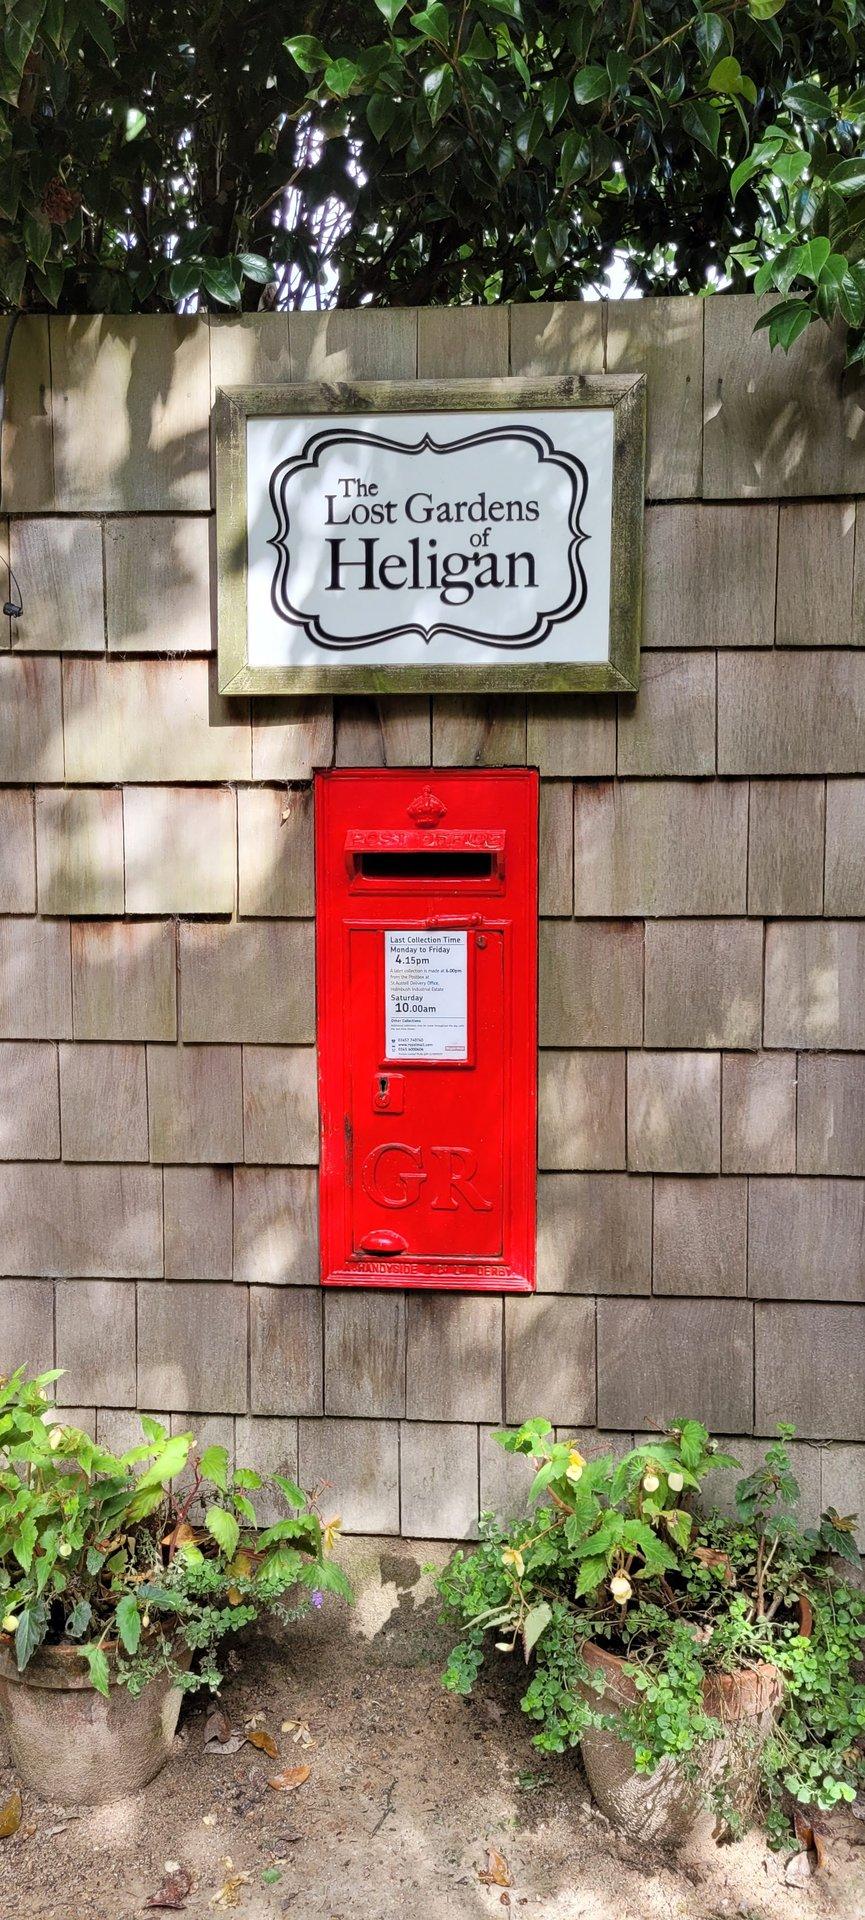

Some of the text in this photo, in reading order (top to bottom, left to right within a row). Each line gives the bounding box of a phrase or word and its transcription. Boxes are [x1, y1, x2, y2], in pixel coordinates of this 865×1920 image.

[338, 478, 379, 497] The
[324, 492, 540, 525] Lost Gardens
[469, 527, 492, 547] of
[324, 536, 539, 606] Heligan
[351, 831, 410, 847] POST
[390, 936, 461, 944] Last Collection Time
[390, 946, 418, 954] Monday
[429, 946, 451, 955] Friday
[395, 954, 430, 966] 4.15pm
[390, 994, 424, 1003] Saturday
[395, 1002, 437, 1013] 10.00am
[361, 1142, 494, 1212] GR
